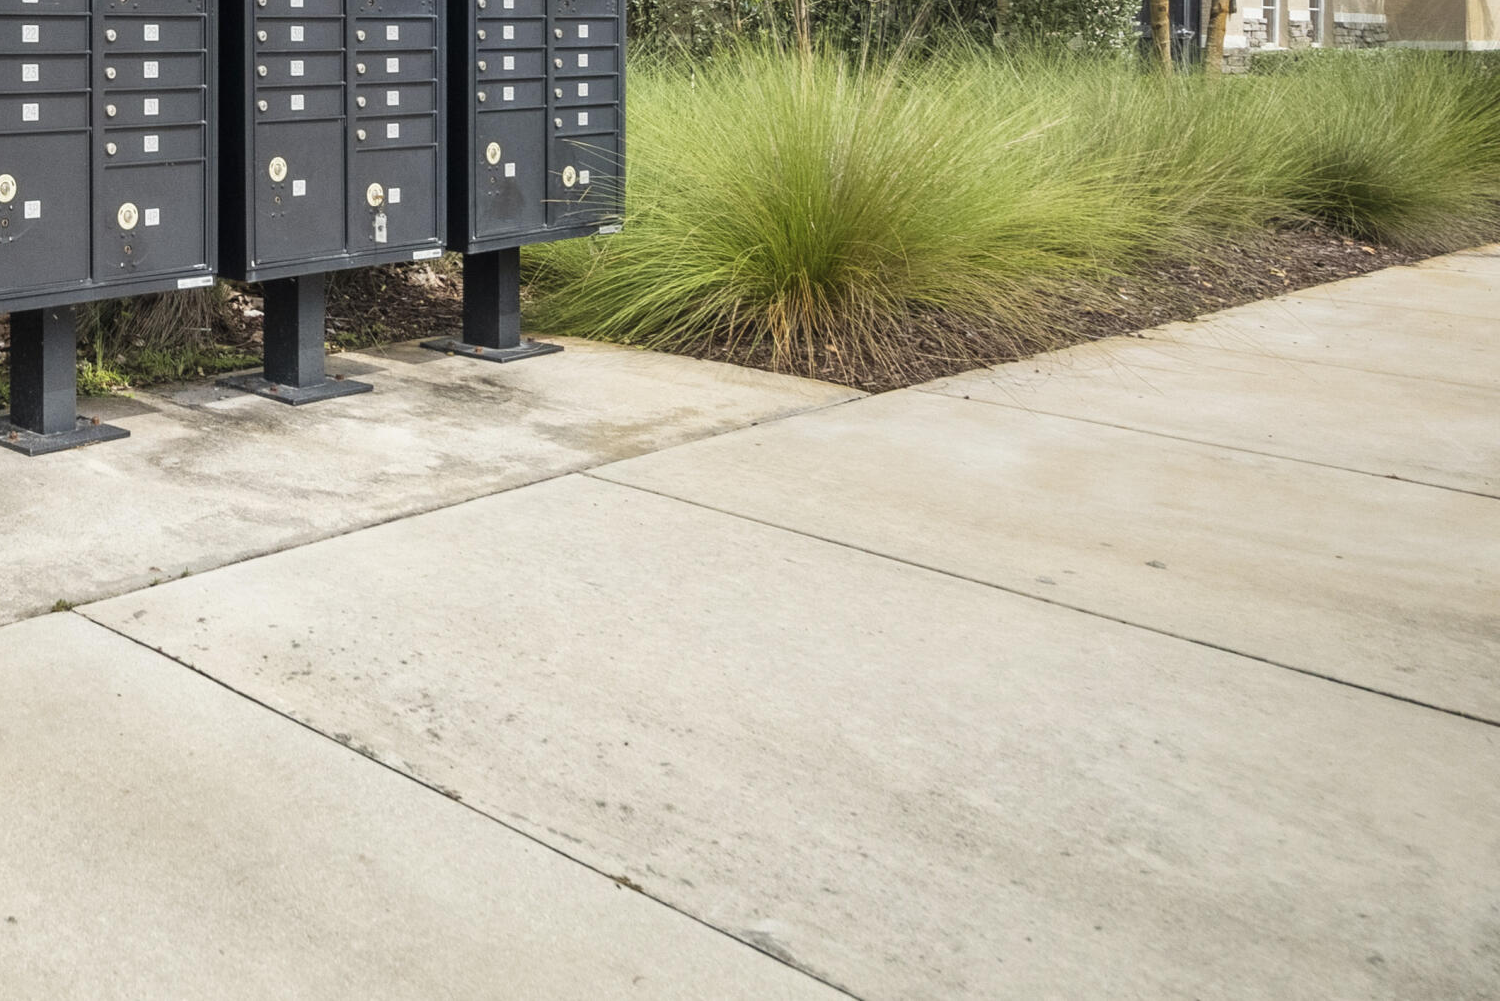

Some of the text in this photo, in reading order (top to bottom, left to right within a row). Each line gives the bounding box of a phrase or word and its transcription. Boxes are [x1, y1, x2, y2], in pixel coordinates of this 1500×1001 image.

[25, 27, 37, 40] 22
[25, 66, 37, 79] 23
[24, 105, 37, 119] 24
